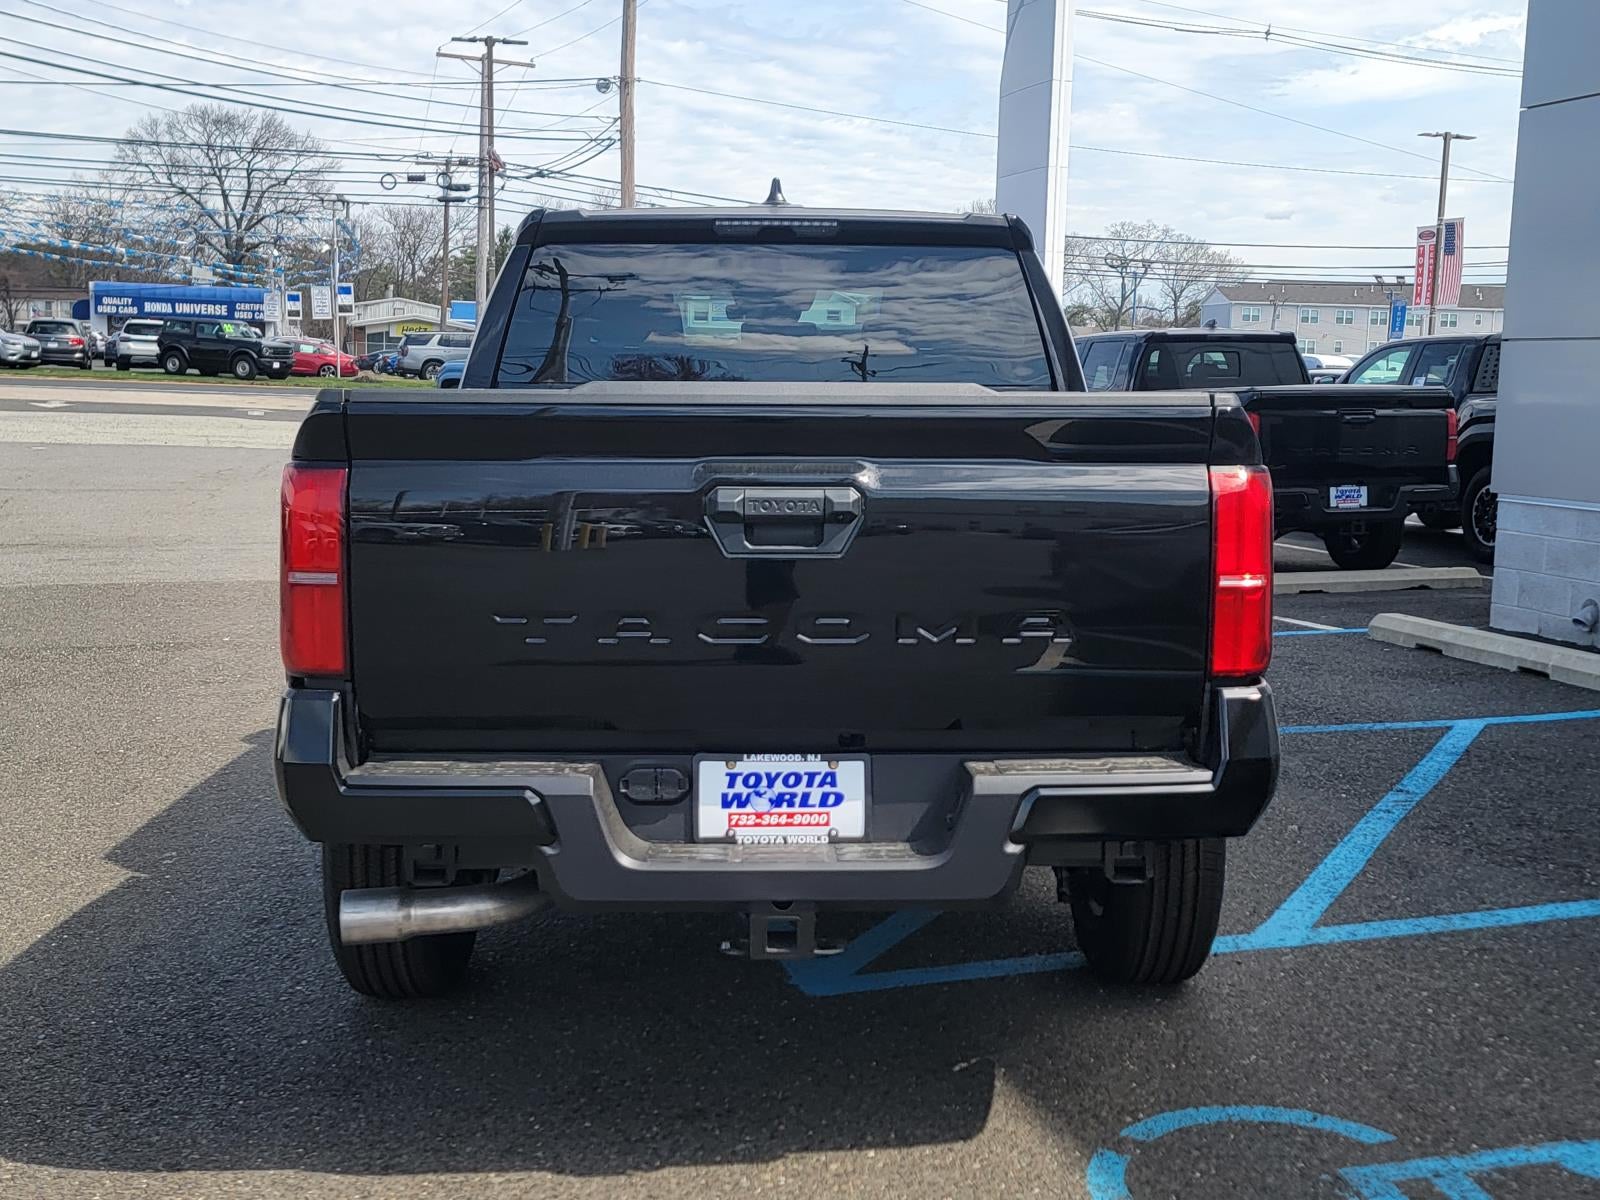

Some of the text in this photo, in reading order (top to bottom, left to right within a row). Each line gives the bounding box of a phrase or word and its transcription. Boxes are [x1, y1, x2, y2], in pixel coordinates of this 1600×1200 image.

[1415, 247, 1424, 303] TOYOTA
[1425, 245, 1435, 304] CERTIFIED
[102, 296, 133, 305] QUALITY
[235, 302, 264, 311] CERTIFI
[97, 305, 138, 314] USED CARS
[144, 301, 228, 316] HONDA UNIVERSE
[234, 311, 264, 320] USED CA
[401, 325, 428, 333] Hertz
[748, 501, 821, 513] TOYOTA
[490, 612, 1073, 645] TACOMA
[725, 771, 838, 788] TOYOTA
[721, 791, 845, 809] WORLD
[730, 813, 828, 826] 732-364-9000
[736, 835, 829, 844] TOYOTA WORLD
